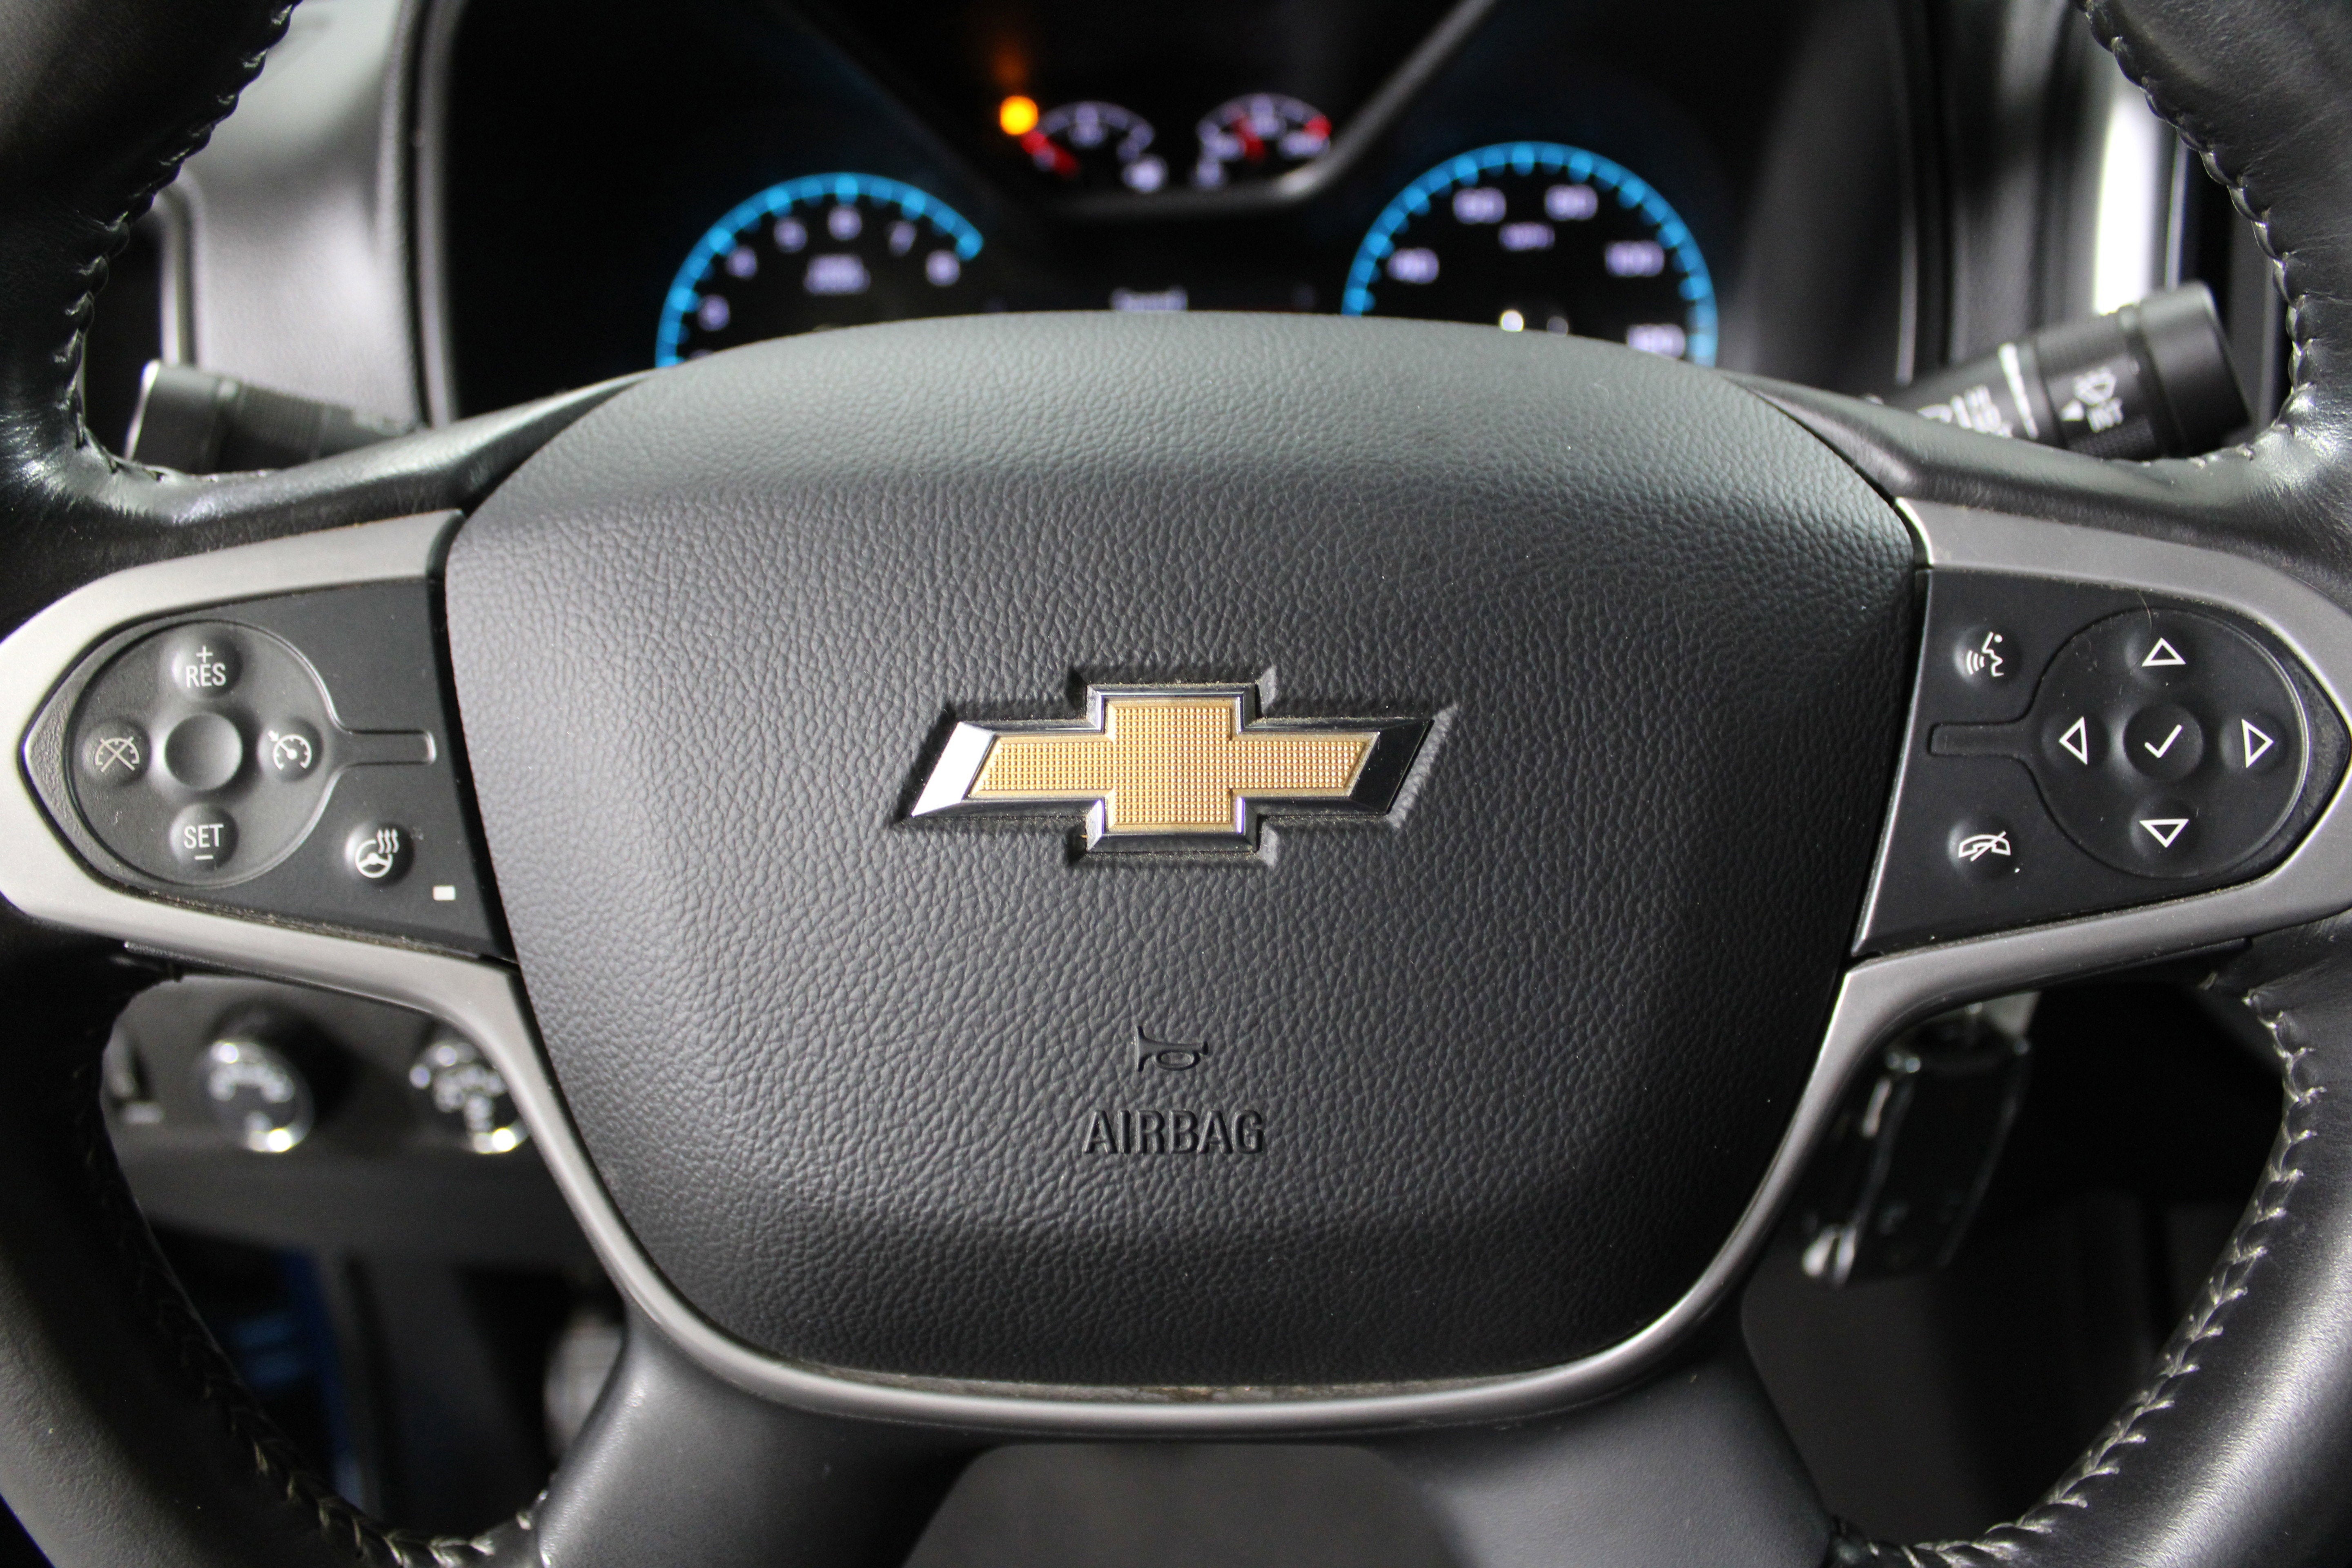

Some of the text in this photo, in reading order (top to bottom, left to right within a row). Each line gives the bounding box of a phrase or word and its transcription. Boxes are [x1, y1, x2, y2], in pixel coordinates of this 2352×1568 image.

[186, 663, 226, 688] RES
[184, 824, 224, 848] SET
[1082, 1109, 1264, 1154] AIRBAG
